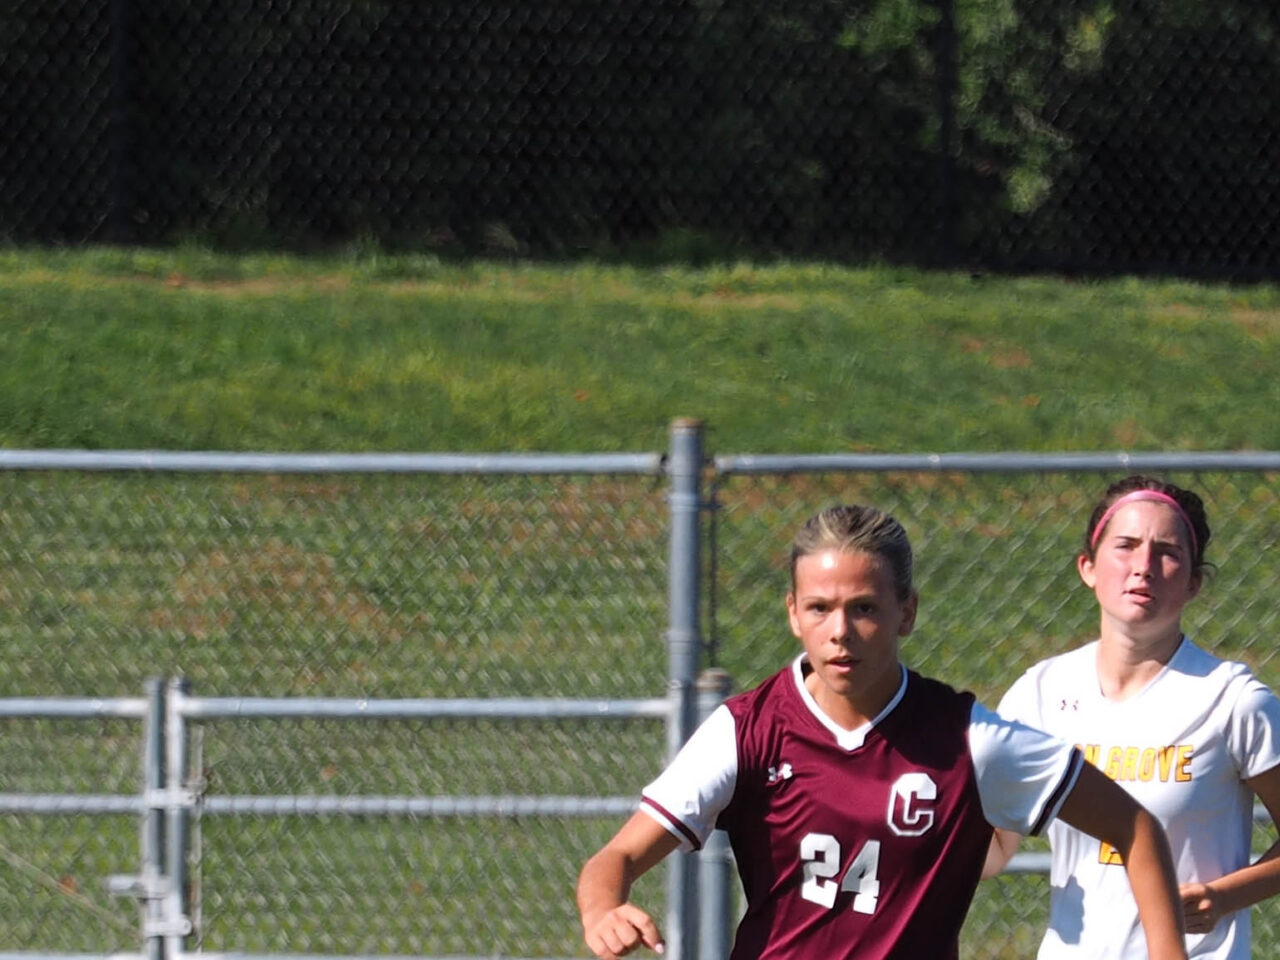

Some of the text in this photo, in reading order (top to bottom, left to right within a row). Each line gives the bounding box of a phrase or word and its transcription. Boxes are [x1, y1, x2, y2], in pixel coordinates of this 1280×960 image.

[1104, 744, 1194, 782] GROVE
[887, 772, 937, 837] C
[800, 832, 881, 915] 24
